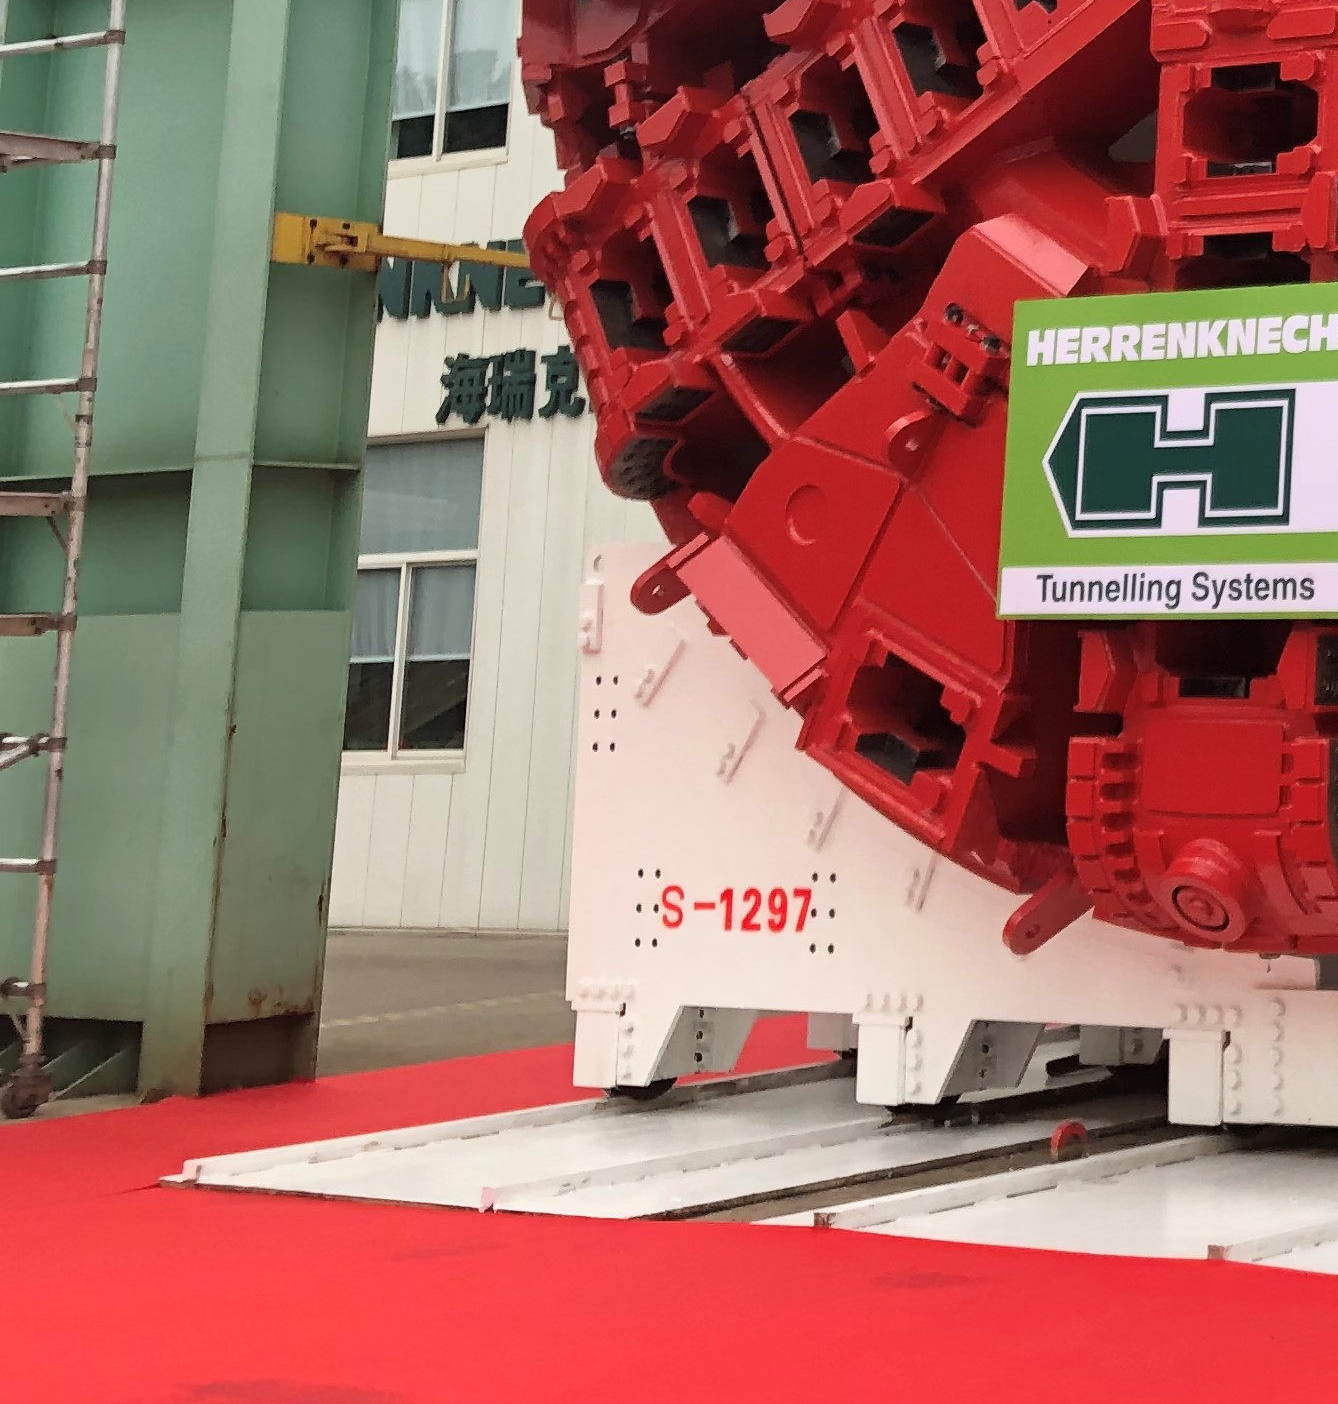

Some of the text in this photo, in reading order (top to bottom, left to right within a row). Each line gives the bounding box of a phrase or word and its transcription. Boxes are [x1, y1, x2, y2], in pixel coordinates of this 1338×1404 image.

[1036, 572, 1315, 609] Tunnelling Systems
[660, 885, 812, 933] S-1297
